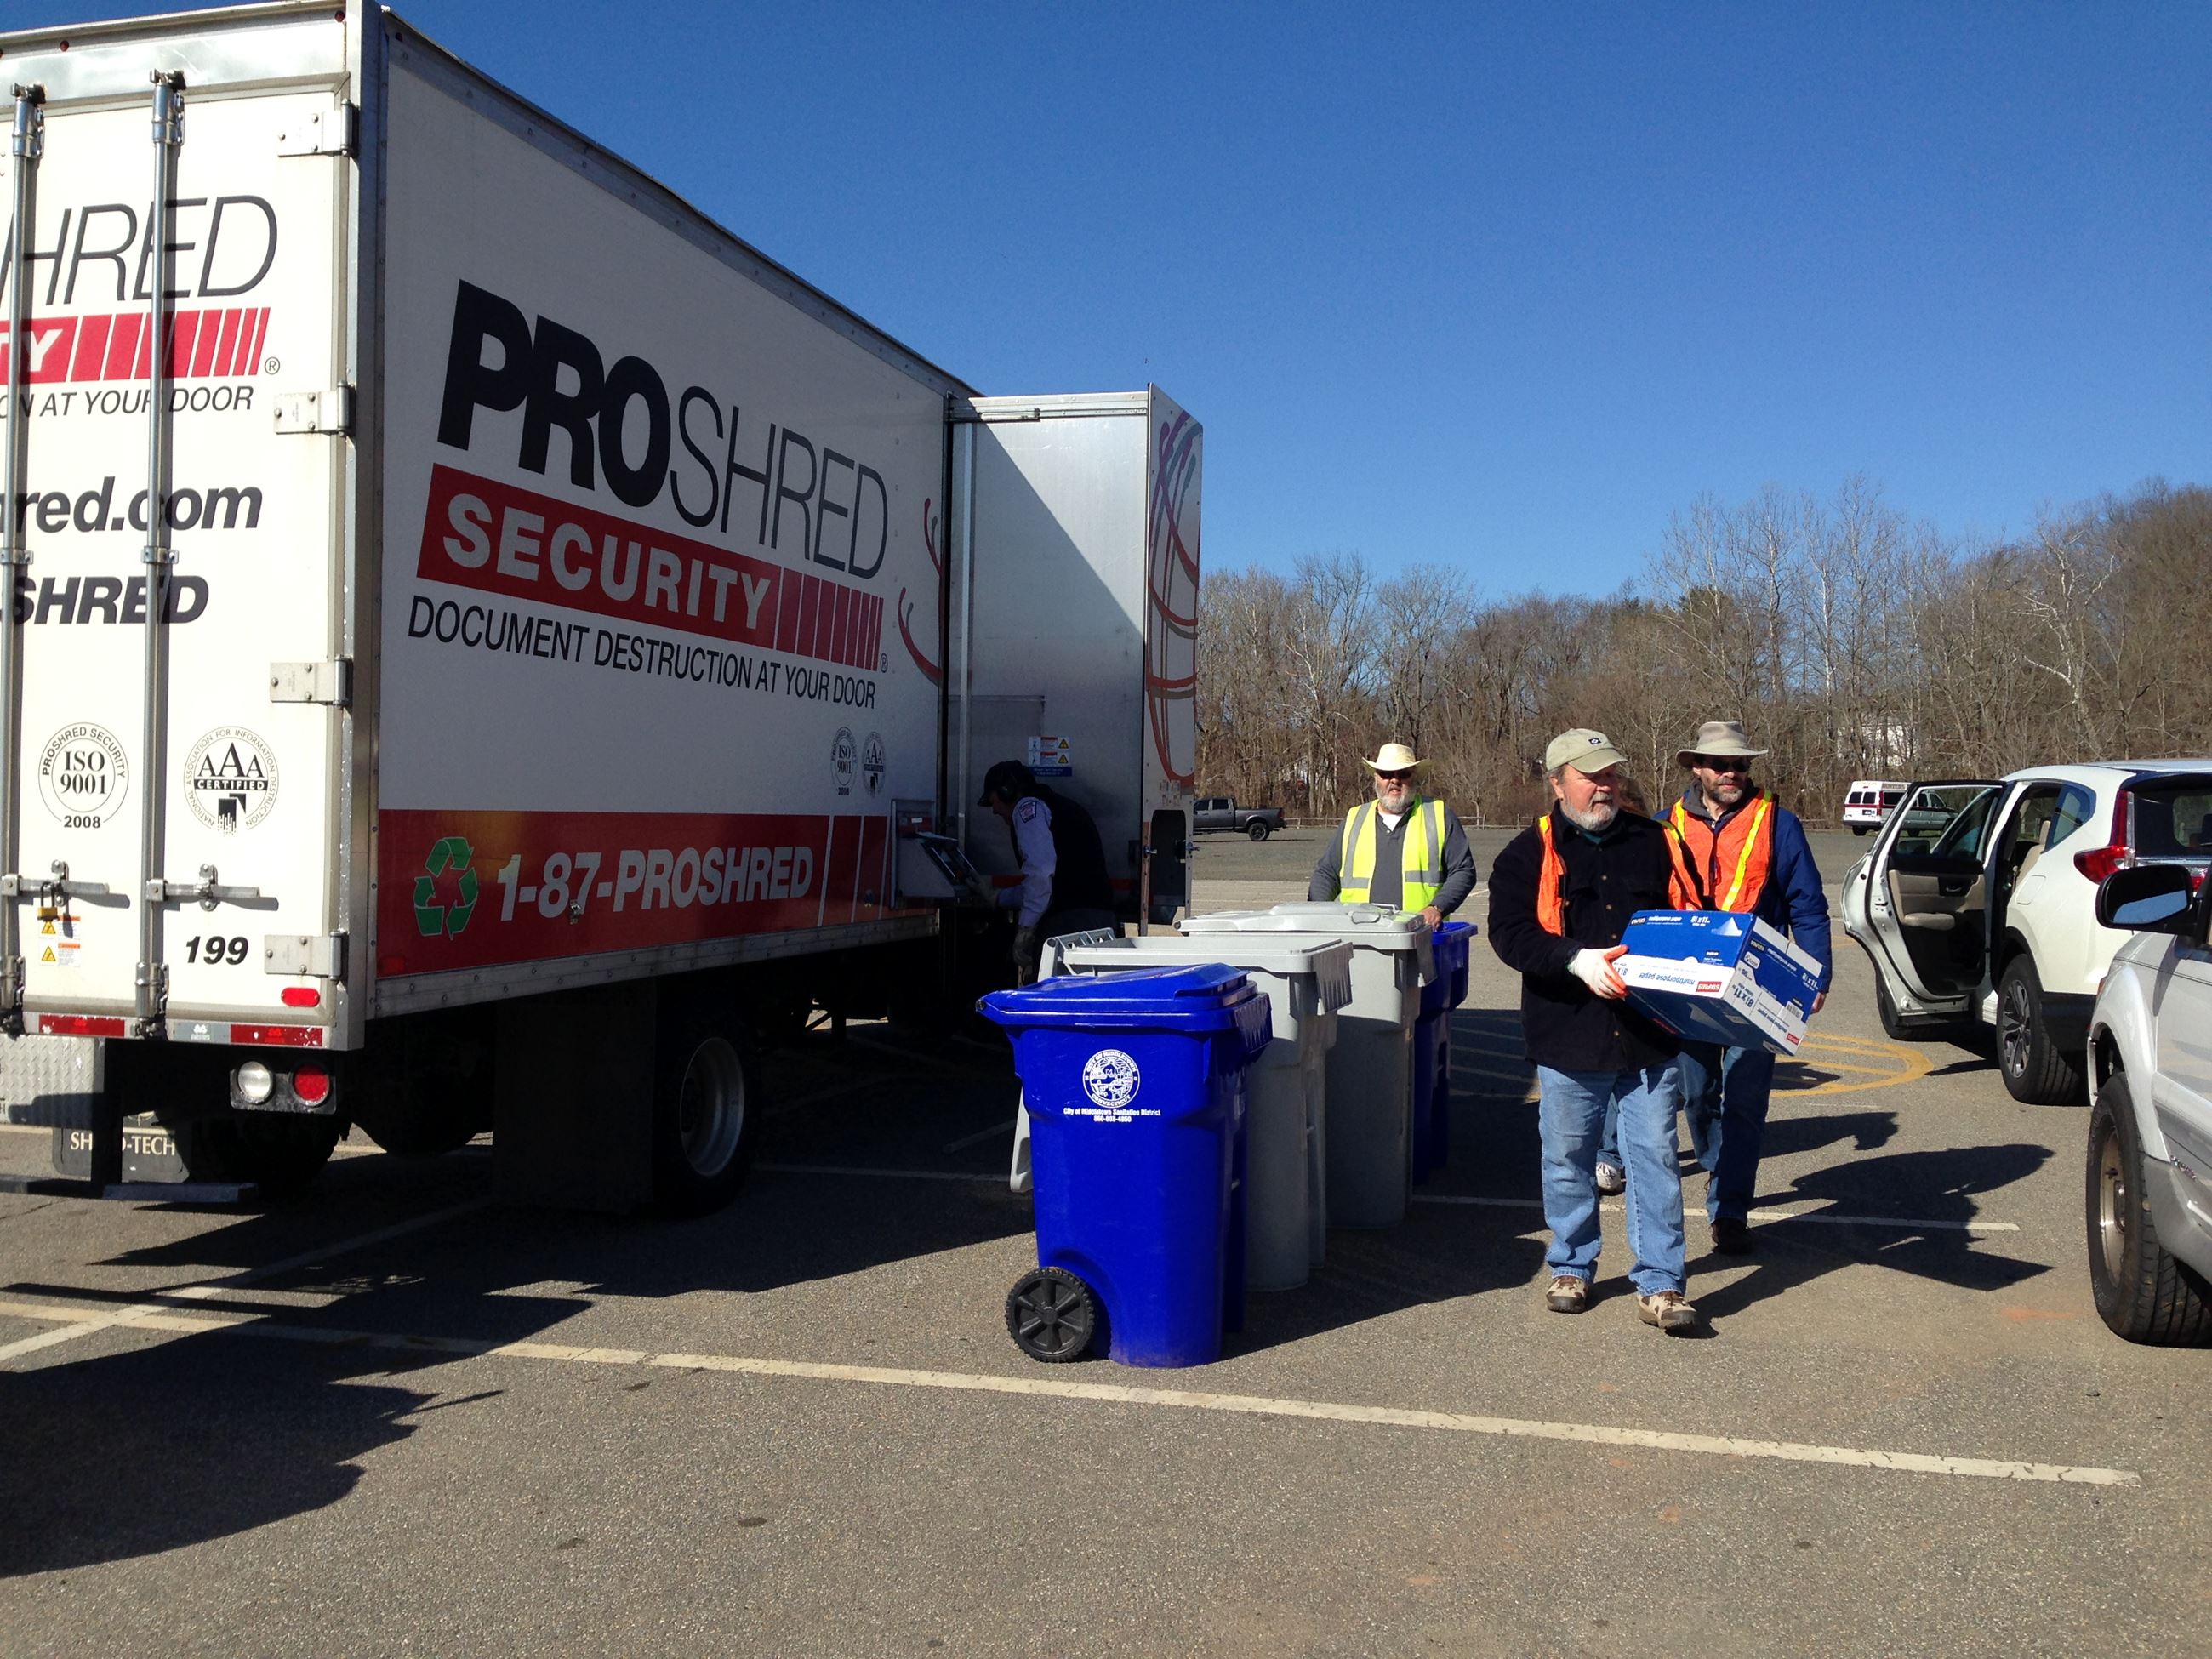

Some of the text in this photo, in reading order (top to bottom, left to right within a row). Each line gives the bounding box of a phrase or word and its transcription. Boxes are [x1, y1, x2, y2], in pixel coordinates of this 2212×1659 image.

[39, 391, 77, 417] AT
[169, 385, 254, 413] DOOR
[437, 279, 887, 579] PROSHRED
[442, 493, 772, 630] SECURITY
[408, 595, 875, 709] DOCUMENT DESTRUCTION AT YOUR DOOR
[42, 727, 125, 778] PROSHRED SECURITY
[64, 750, 105, 772] ISO
[197, 742, 265, 778] AAA
[60, 773, 106, 795] 9001
[186, 729, 276, 827] NATIONAL ASSOCIATION FOR INFORMATION DESTRUCTION
[197, 780, 265, 790] CERTIFIED
[64, 815, 101, 829] 2008
[496, 847, 813, 921] 1-87-PROSHRED
[185, 936, 249, 965] 199
[71, 1132, 175, 1156] SH-TECH
